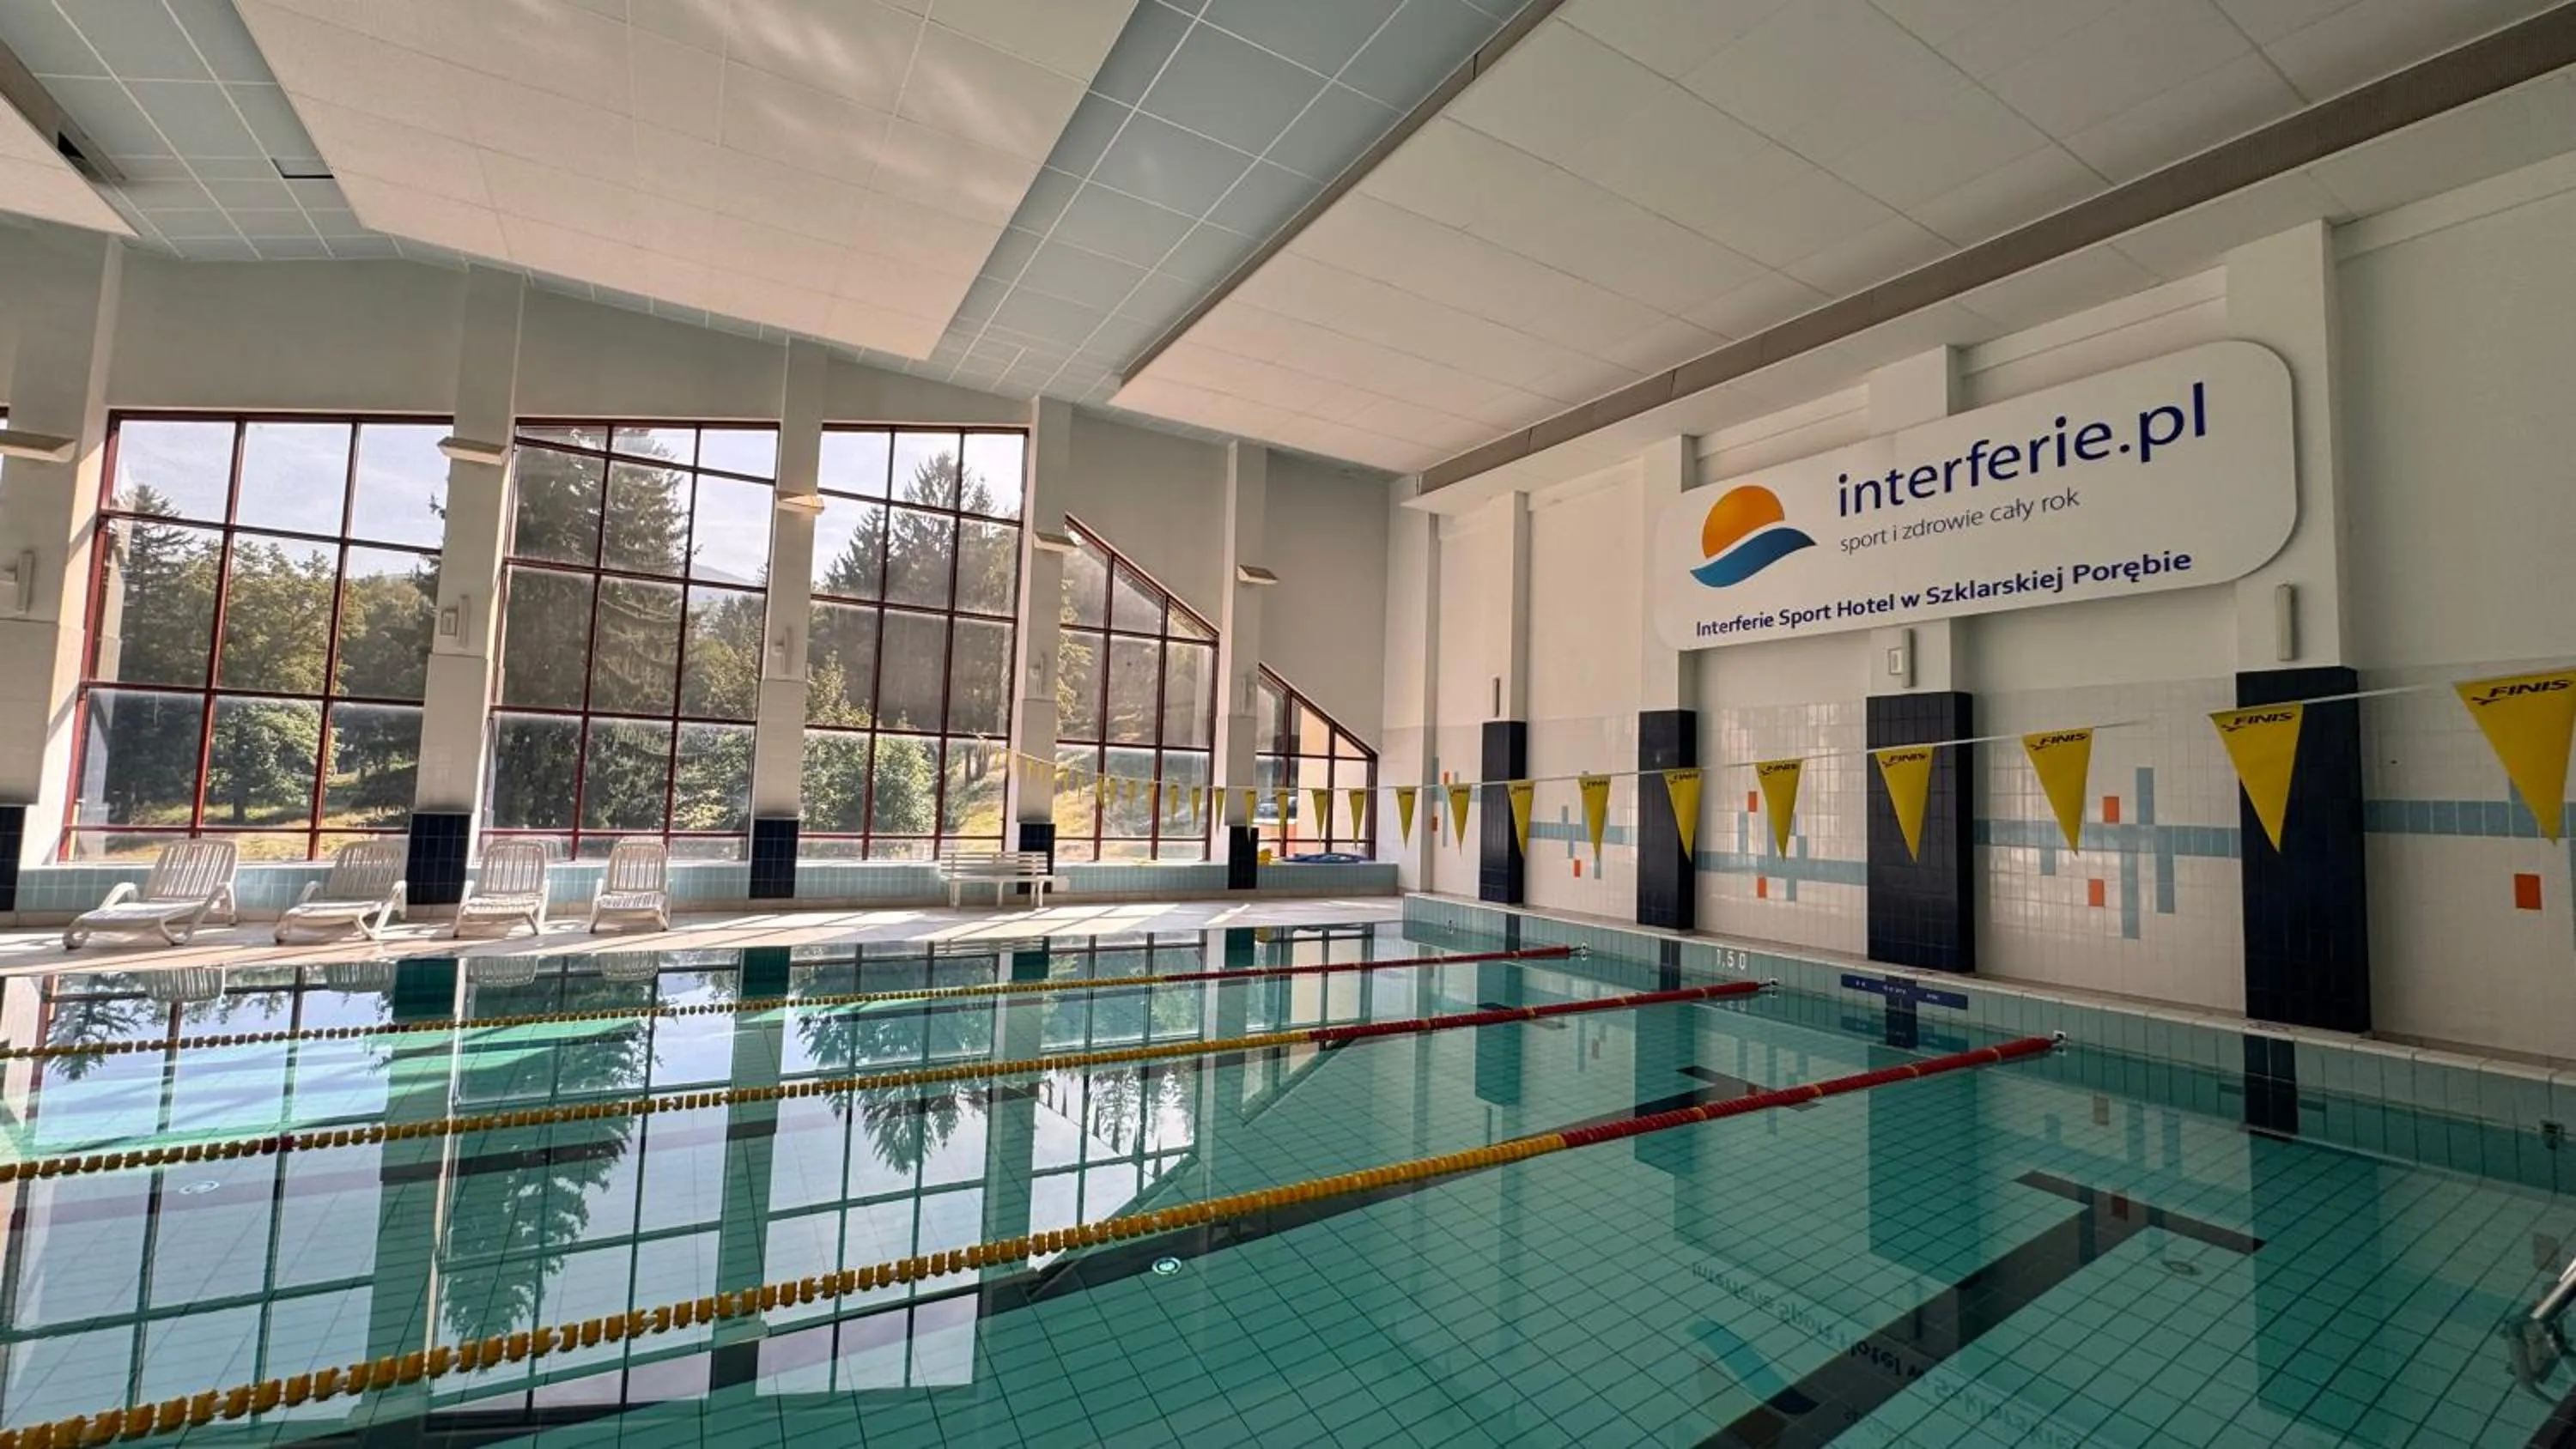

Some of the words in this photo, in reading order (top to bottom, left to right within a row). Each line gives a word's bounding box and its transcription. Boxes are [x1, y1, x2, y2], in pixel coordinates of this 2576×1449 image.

[1838, 381, 2207, 518] interferie.pl
[1839, 529, 1888, 556] sport
[1892, 524, 1899, 543] i
[1902, 507, 1985, 540] zdrowie
[1990, 498, 2035, 523] cały
[2041, 486, 2081, 513] rok
[1695, 610, 1776, 638] Interferie
[1777, 603, 1832, 629] Sport
[1836, 592, 1896, 619] Hotel
[1899, 593, 1923, 610] w
[1925, 566, 2065, 605] Szklarskiej
[2071, 549, 2193, 585] Porębie
[2488, 679, 2573, 698] FINIS
[2039, 731, 2089, 746] FINIS
[2234, 712, 2295, 725] FINIS
